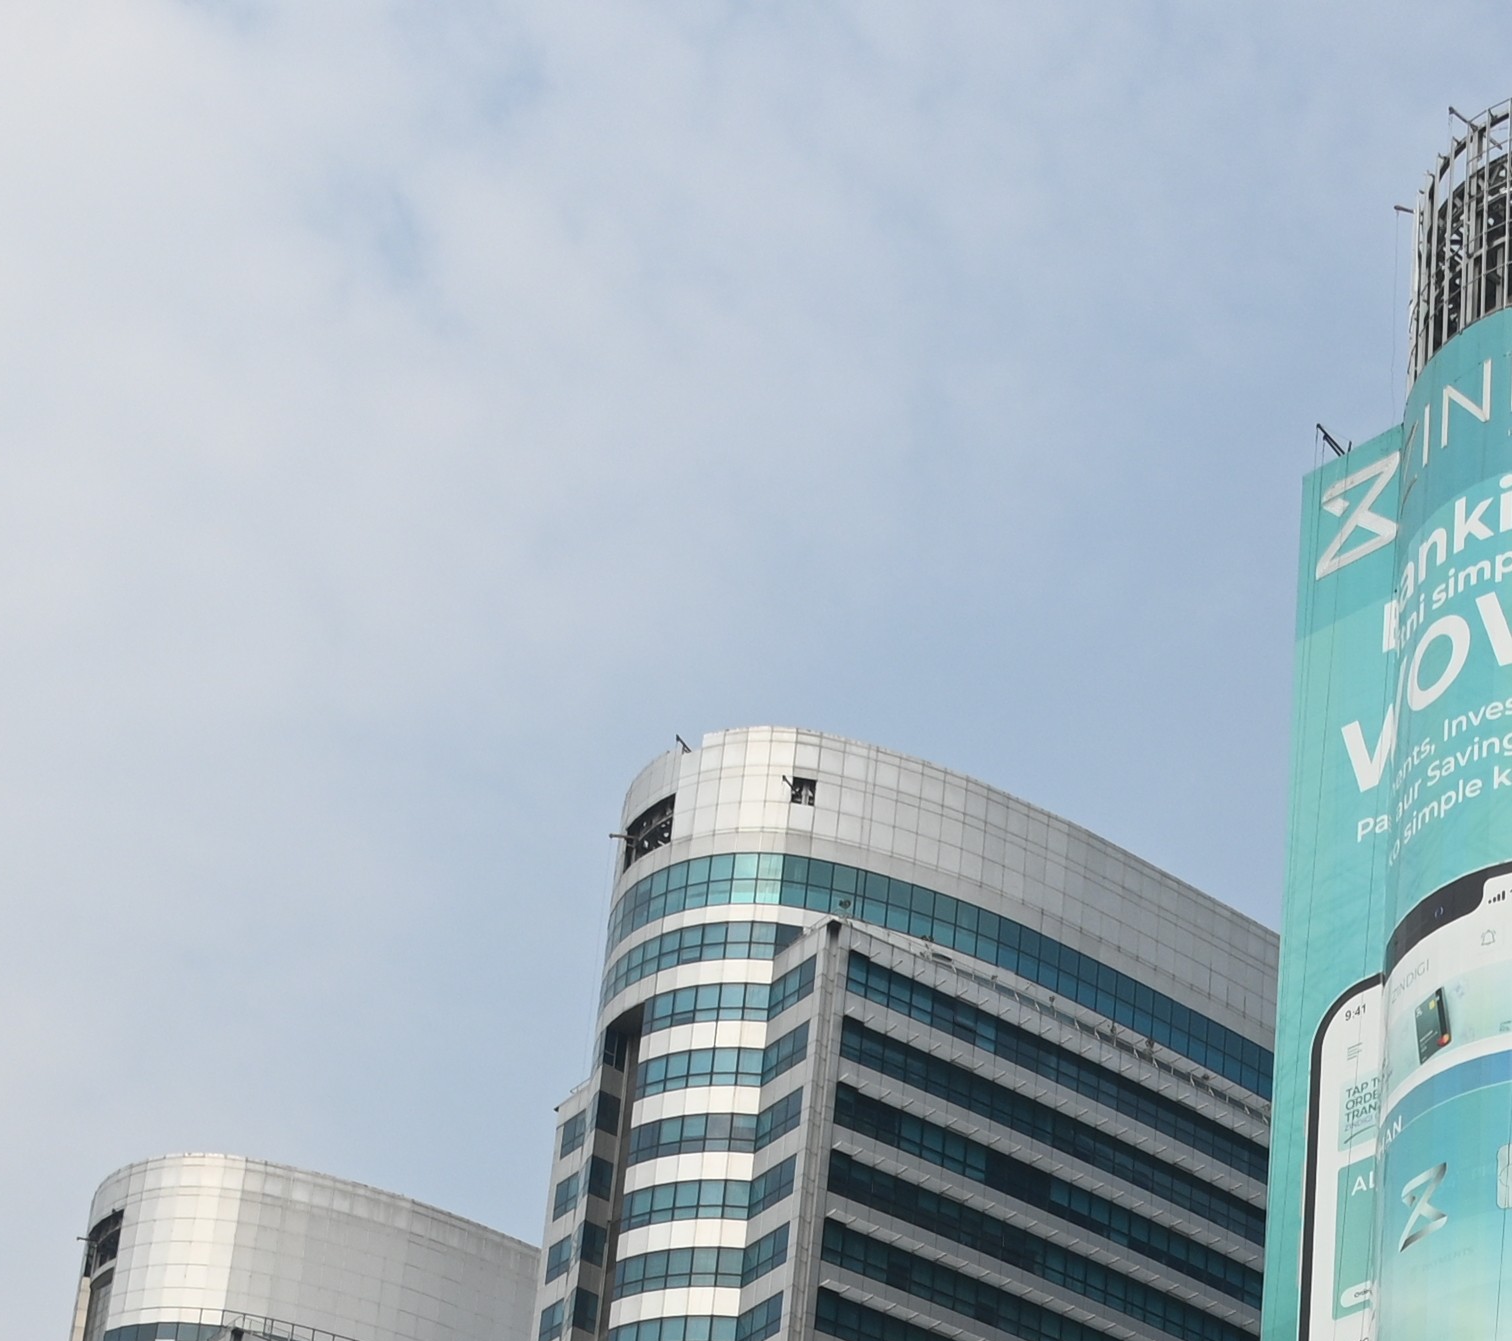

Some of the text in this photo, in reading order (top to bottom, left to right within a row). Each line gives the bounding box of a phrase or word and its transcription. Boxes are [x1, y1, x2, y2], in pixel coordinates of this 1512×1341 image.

[1403, 776, 1483, 845] simple
[1344, 1003, 1367, 1021] 9:41
[1346, 1080, 1369, 1099] TAP
